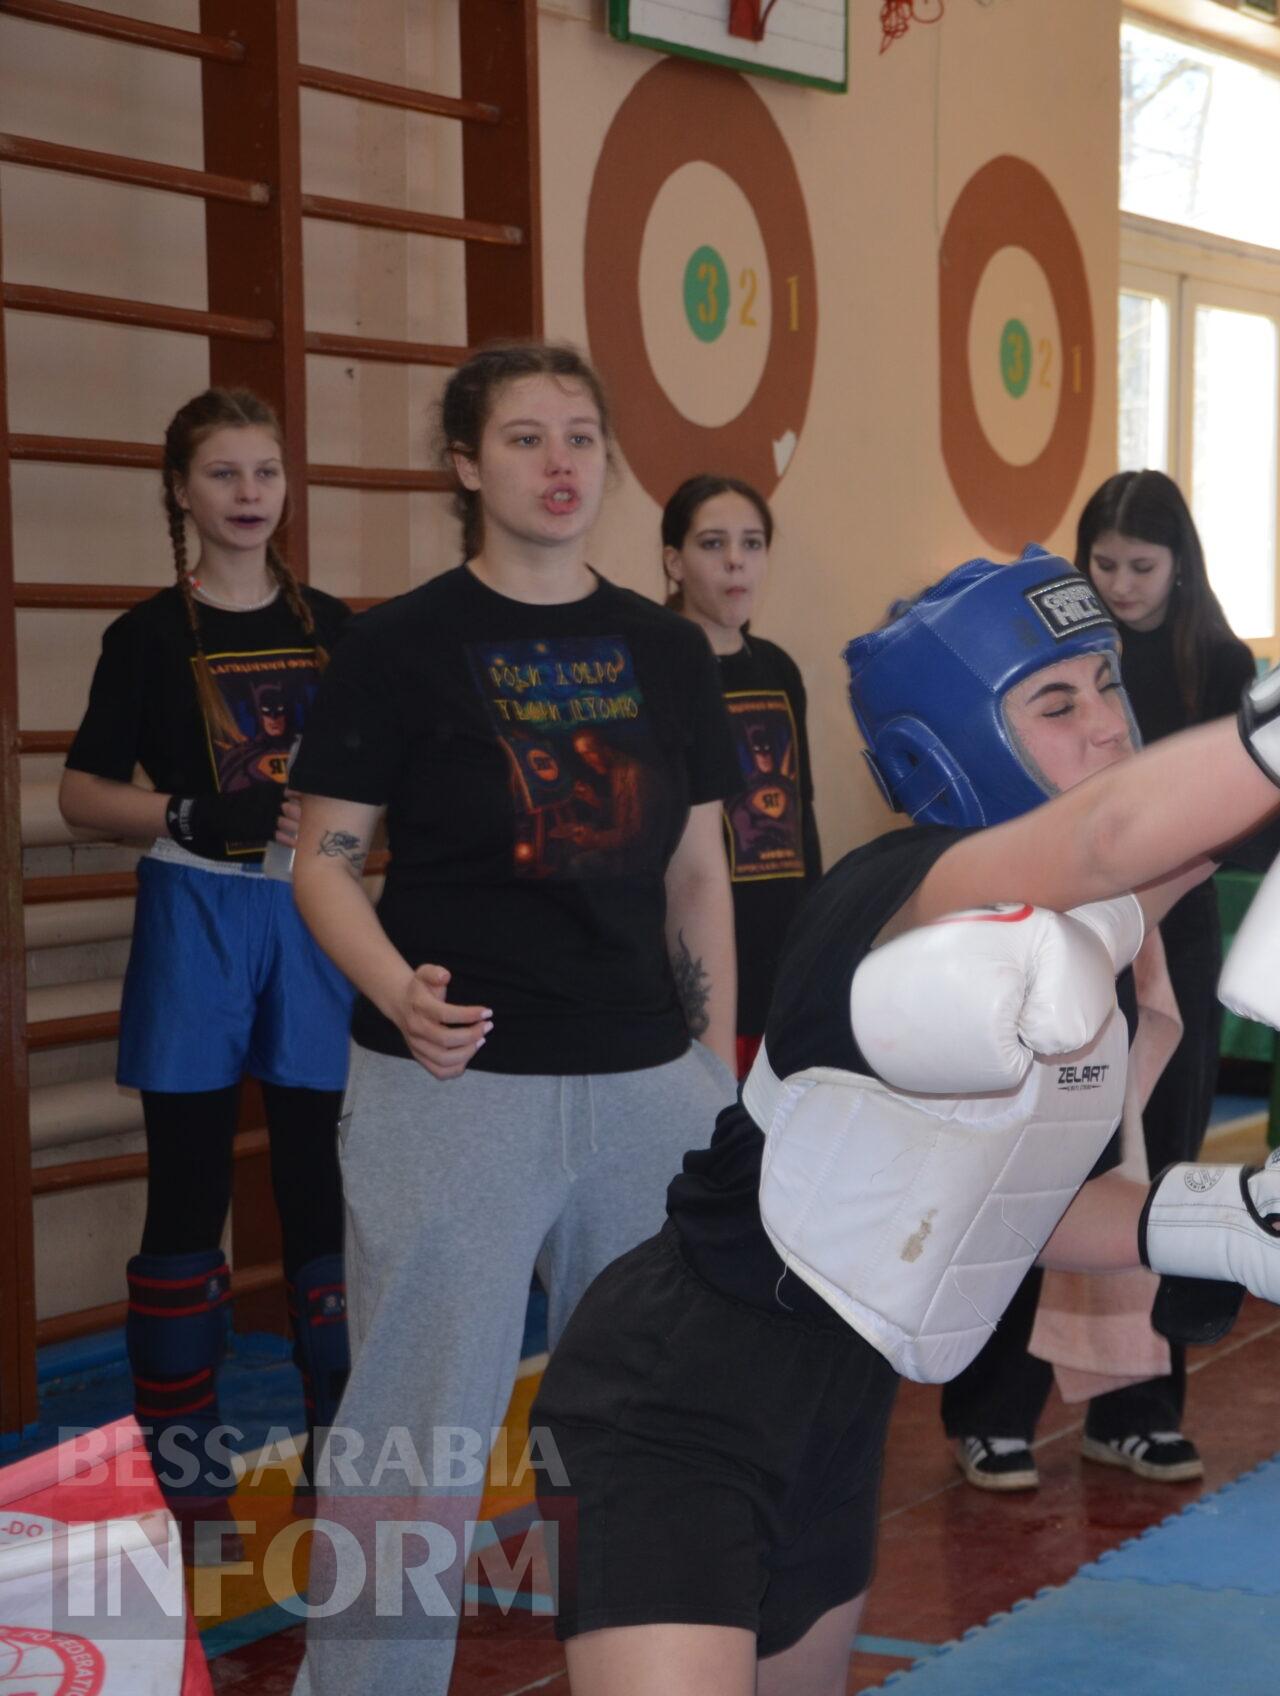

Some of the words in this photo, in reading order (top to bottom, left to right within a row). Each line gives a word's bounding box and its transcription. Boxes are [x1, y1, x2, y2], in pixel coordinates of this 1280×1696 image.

[698, 263, 718, 324] 3
[739, 268, 757, 327] 2
[787, 275, 799, 331] 1
[1007, 334, 1025, 385] 3
[1039, 338, 1053, 390] 2
[1072, 345, 1082, 394] 1
[1057, 1064, 1110, 1084] ZELART
